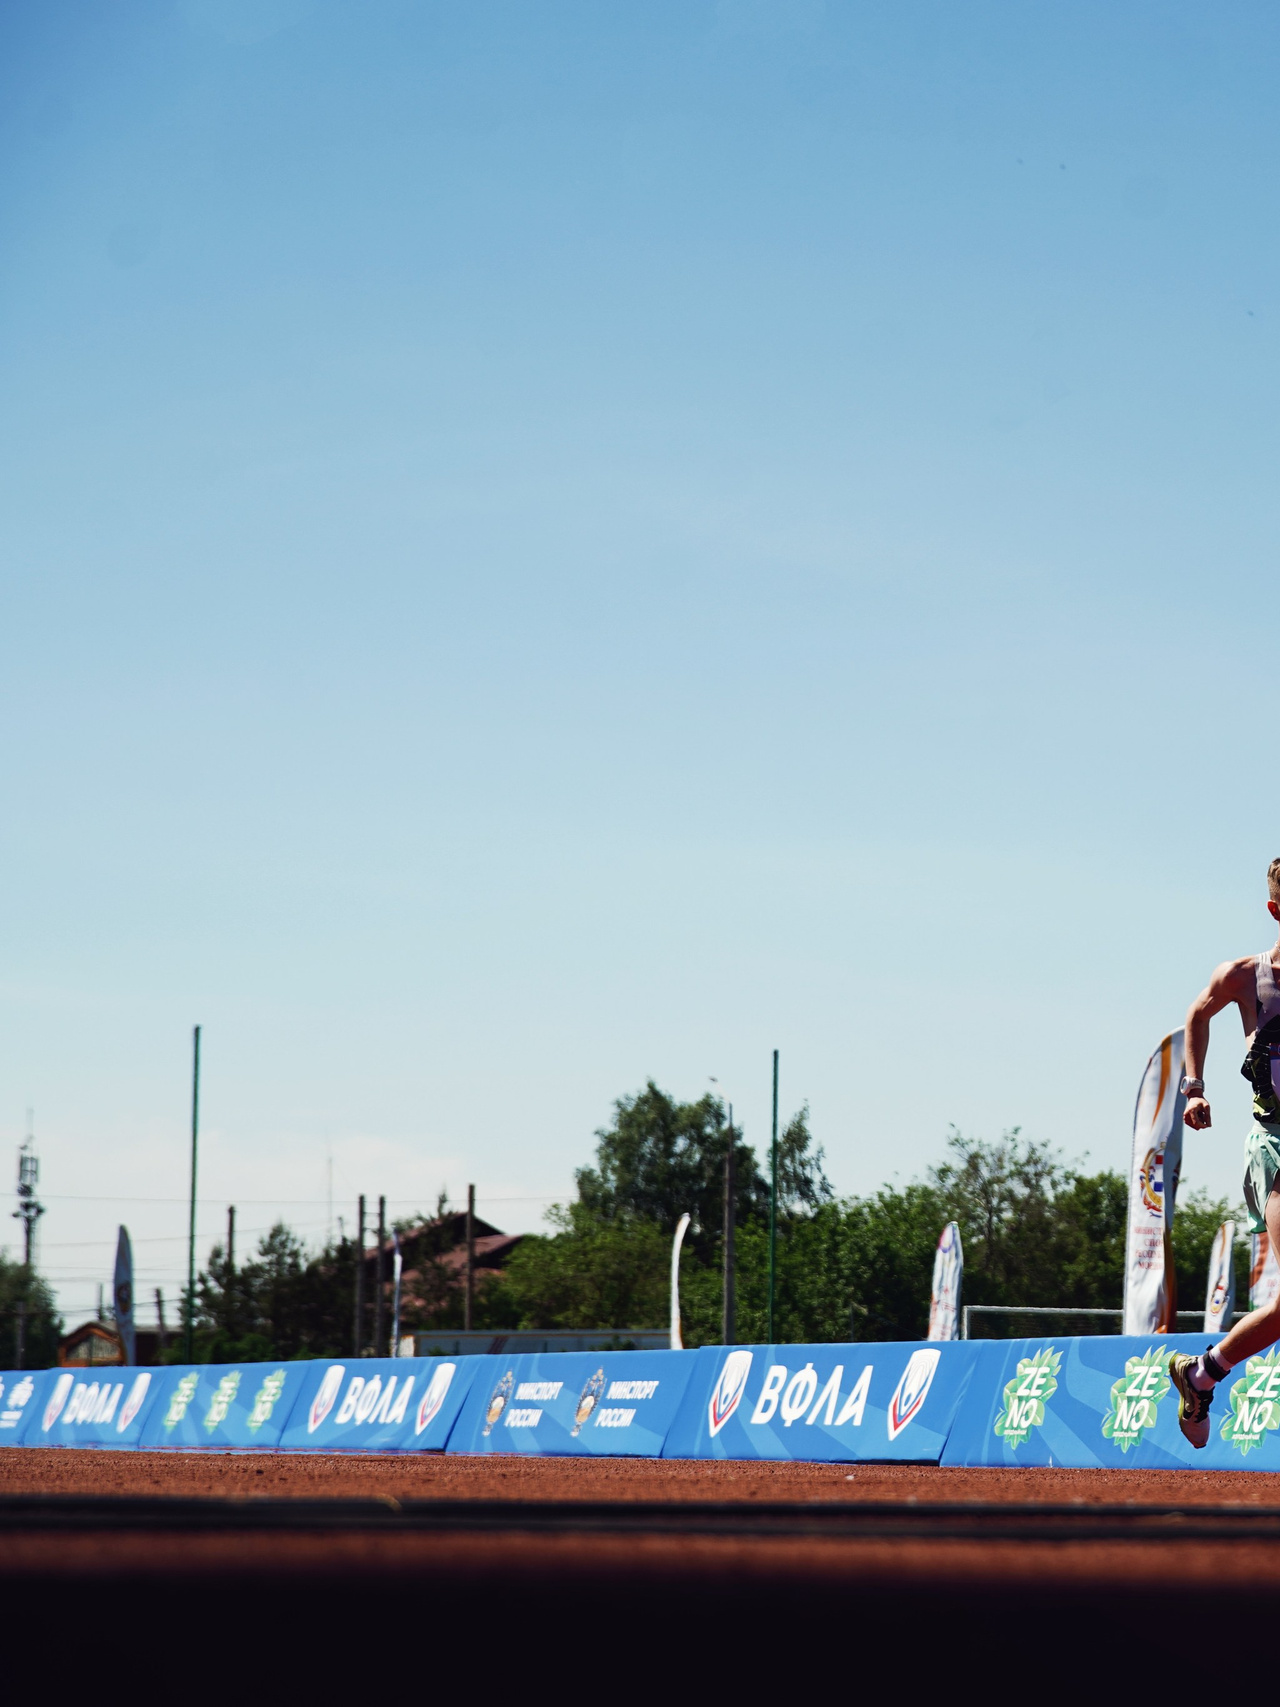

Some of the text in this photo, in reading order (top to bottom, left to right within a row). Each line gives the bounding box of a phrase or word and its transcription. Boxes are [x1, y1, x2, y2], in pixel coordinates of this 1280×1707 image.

[514, 1382, 564, 1400] МИНСПОРТ
[606, 1381, 660, 1400] МИНСПОРТ
[750, 1362, 874, 1427] ВФЛА
[1016, 1366, 1051, 1396] ZE
[1125, 1366, 1163, 1396] ZE
[334, 1374, 416, 1426] ВФЛА
[1004, 1398, 1038, 1428] NO
[1113, 1398, 1150, 1431] NO
[504, 1408, 543, 1427] РОССИИ
[594, 1408, 637, 1427] РОССИИ
[1233, 1400, 1274, 1433] NO
